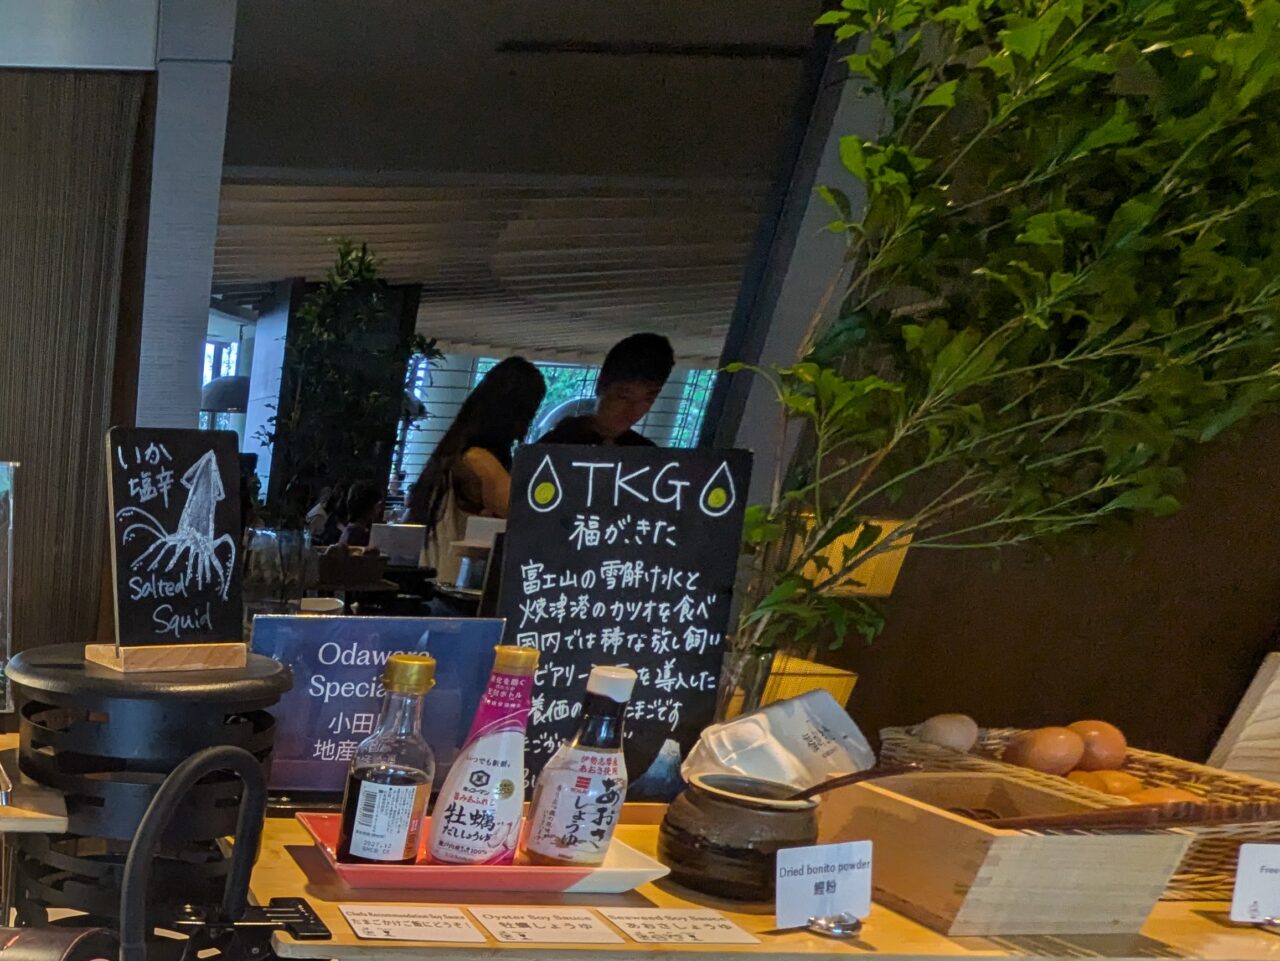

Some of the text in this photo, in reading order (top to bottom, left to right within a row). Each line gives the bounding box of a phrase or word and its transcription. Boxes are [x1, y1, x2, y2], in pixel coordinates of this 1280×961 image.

[117, 442, 173, 470] いか
[128, 466, 174, 508] 塩辛
[572, 462, 690, 510] TKG
[569, 514, 676, 550] 福がきた
[128, 572, 188, 600] Salted
[520, 559, 700, 593] 富士山の雪解け水と
[152, 600, 213, 638] Squid
[520, 595, 717, 629] 焼津港のカツオを食べ
[309, 674, 387, 703] Specia
[779, 857, 871, 878] Dried bonito powder
[428, 913, 443, 921] Soy
[482, 913, 525, 921] Oyster
[527, 914, 551, 922] Soy
[664, 914, 687, 922] Soy
